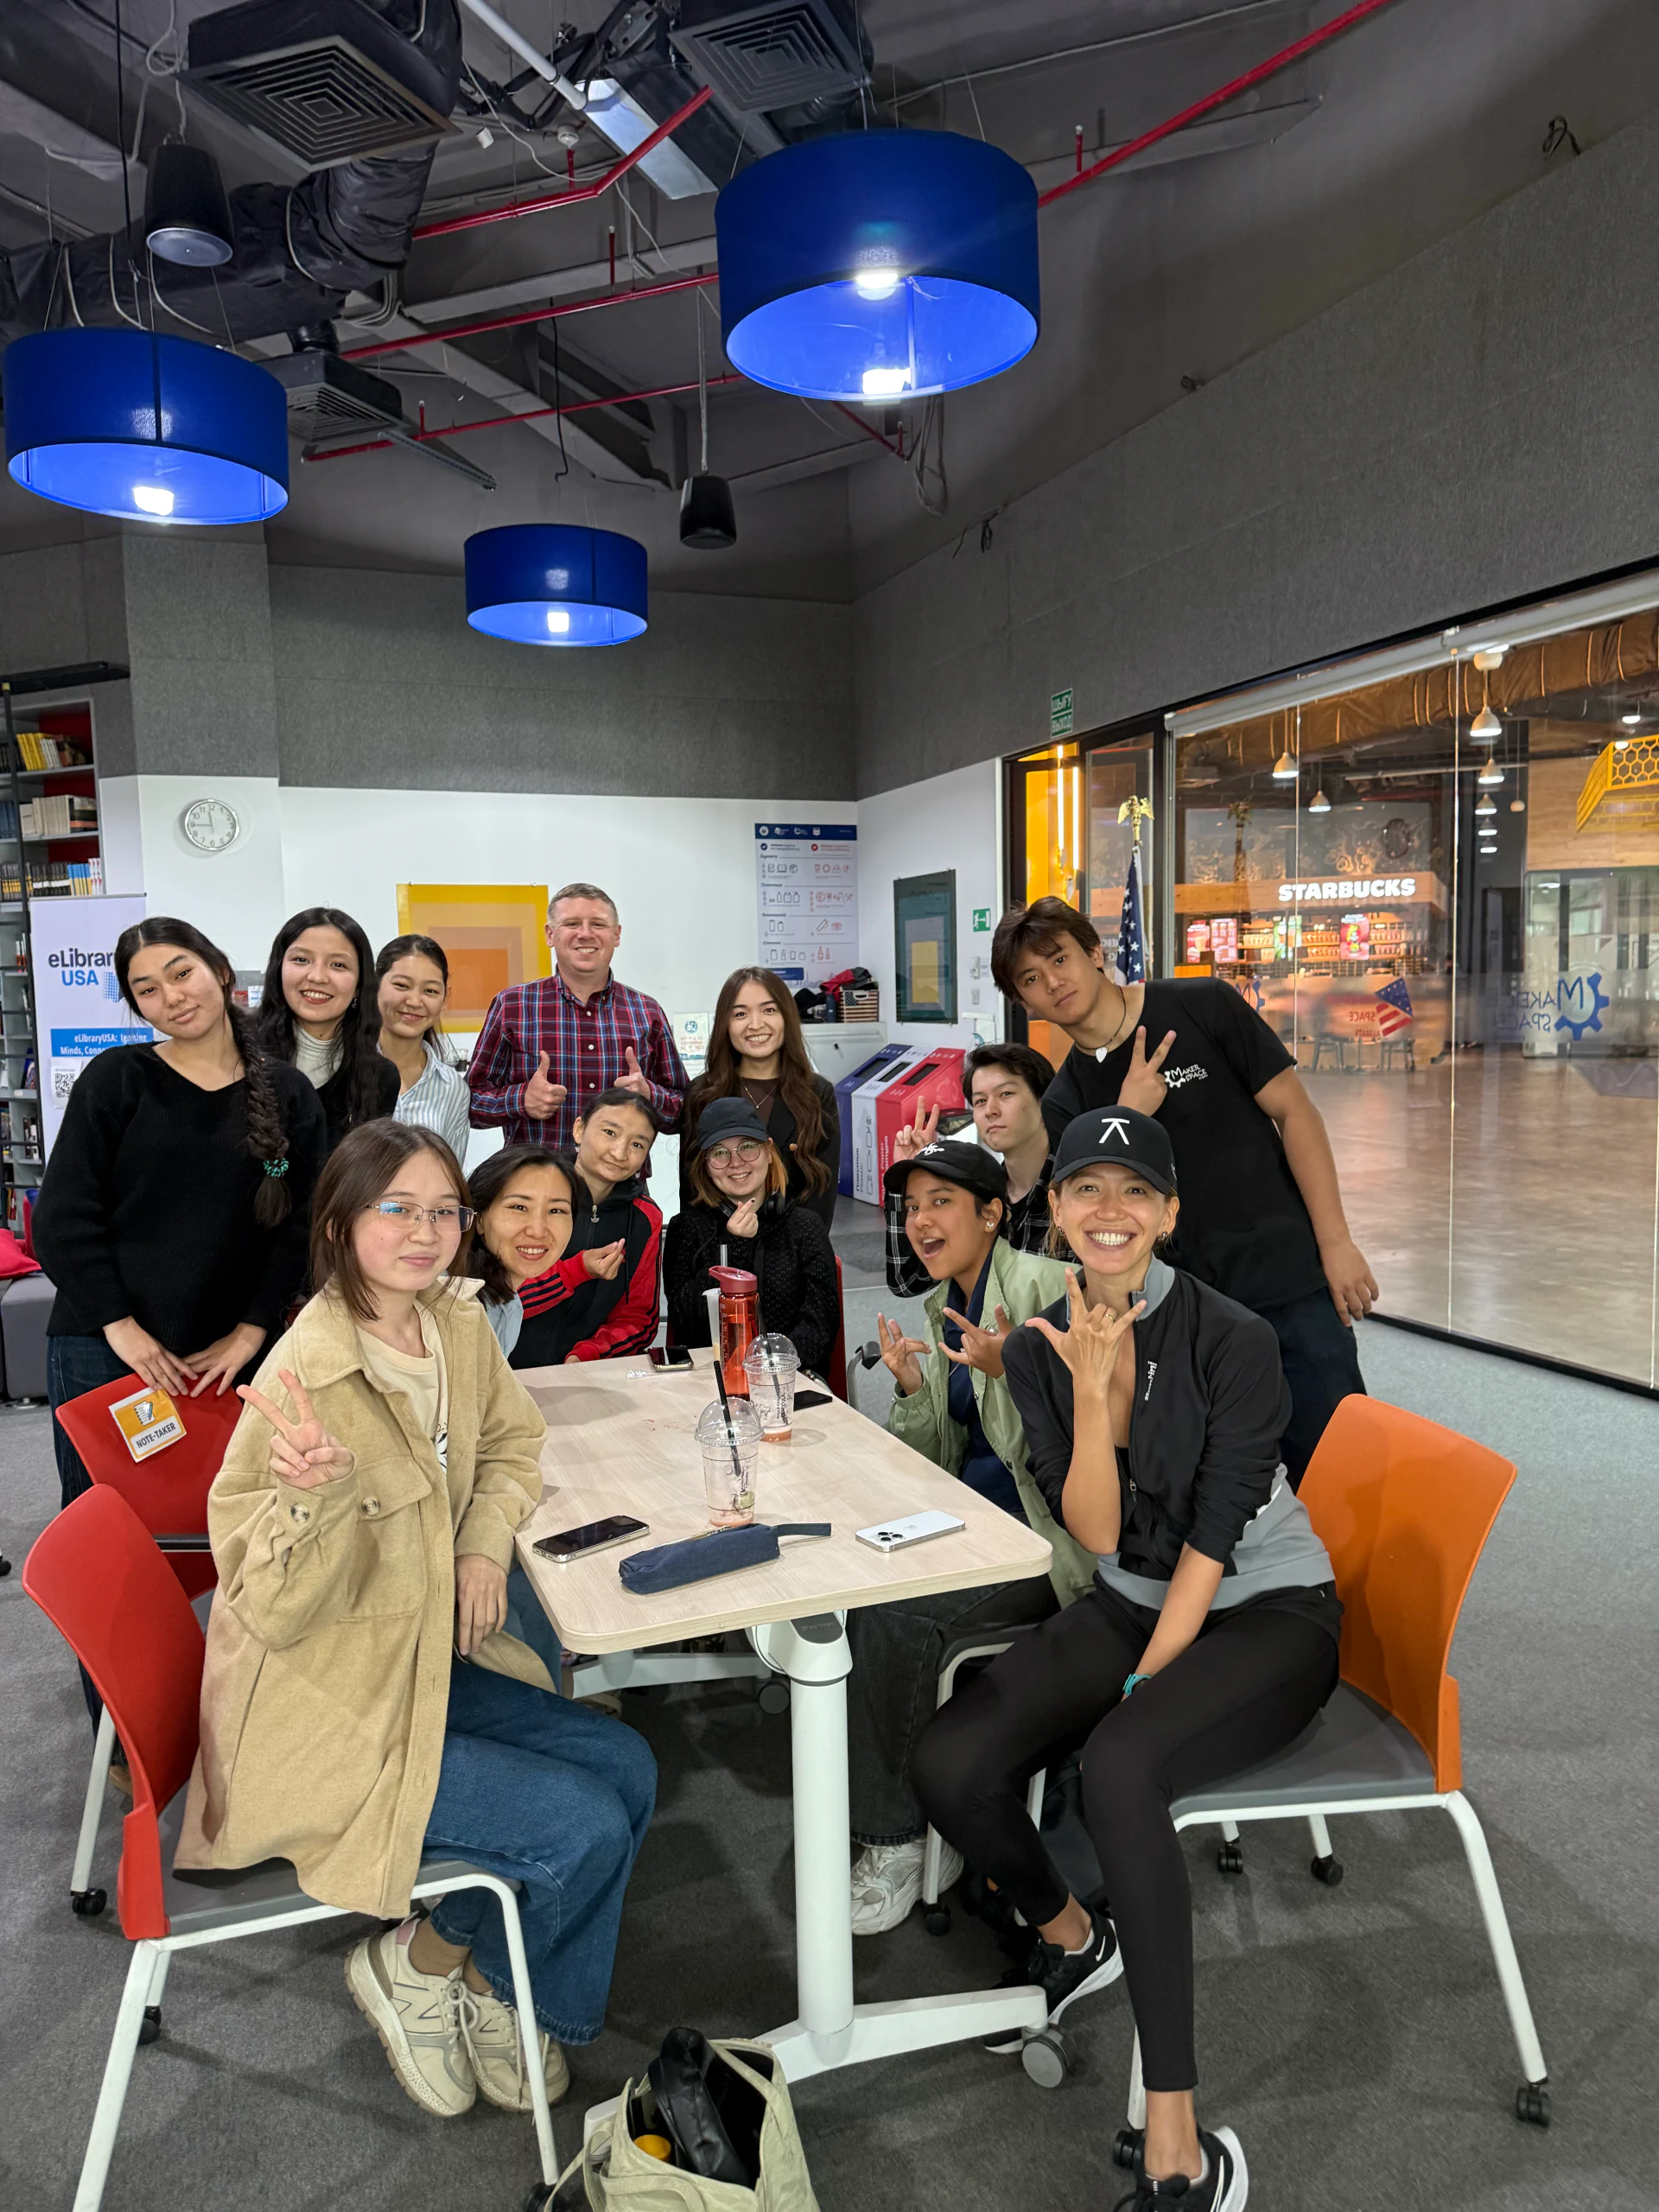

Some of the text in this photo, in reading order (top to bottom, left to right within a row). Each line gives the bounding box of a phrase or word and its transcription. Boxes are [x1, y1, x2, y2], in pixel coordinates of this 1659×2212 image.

[1279, 879, 1415, 901] STARBUCKS
[48, 948, 113, 968] eLibrar
[61, 970, 99, 986] USA
[74, 1033, 118, 1045] eLibraryUSA:
[60, 1046, 83, 1056] Minds,
[136, 1422, 176, 1449] NOTE-TAKER
